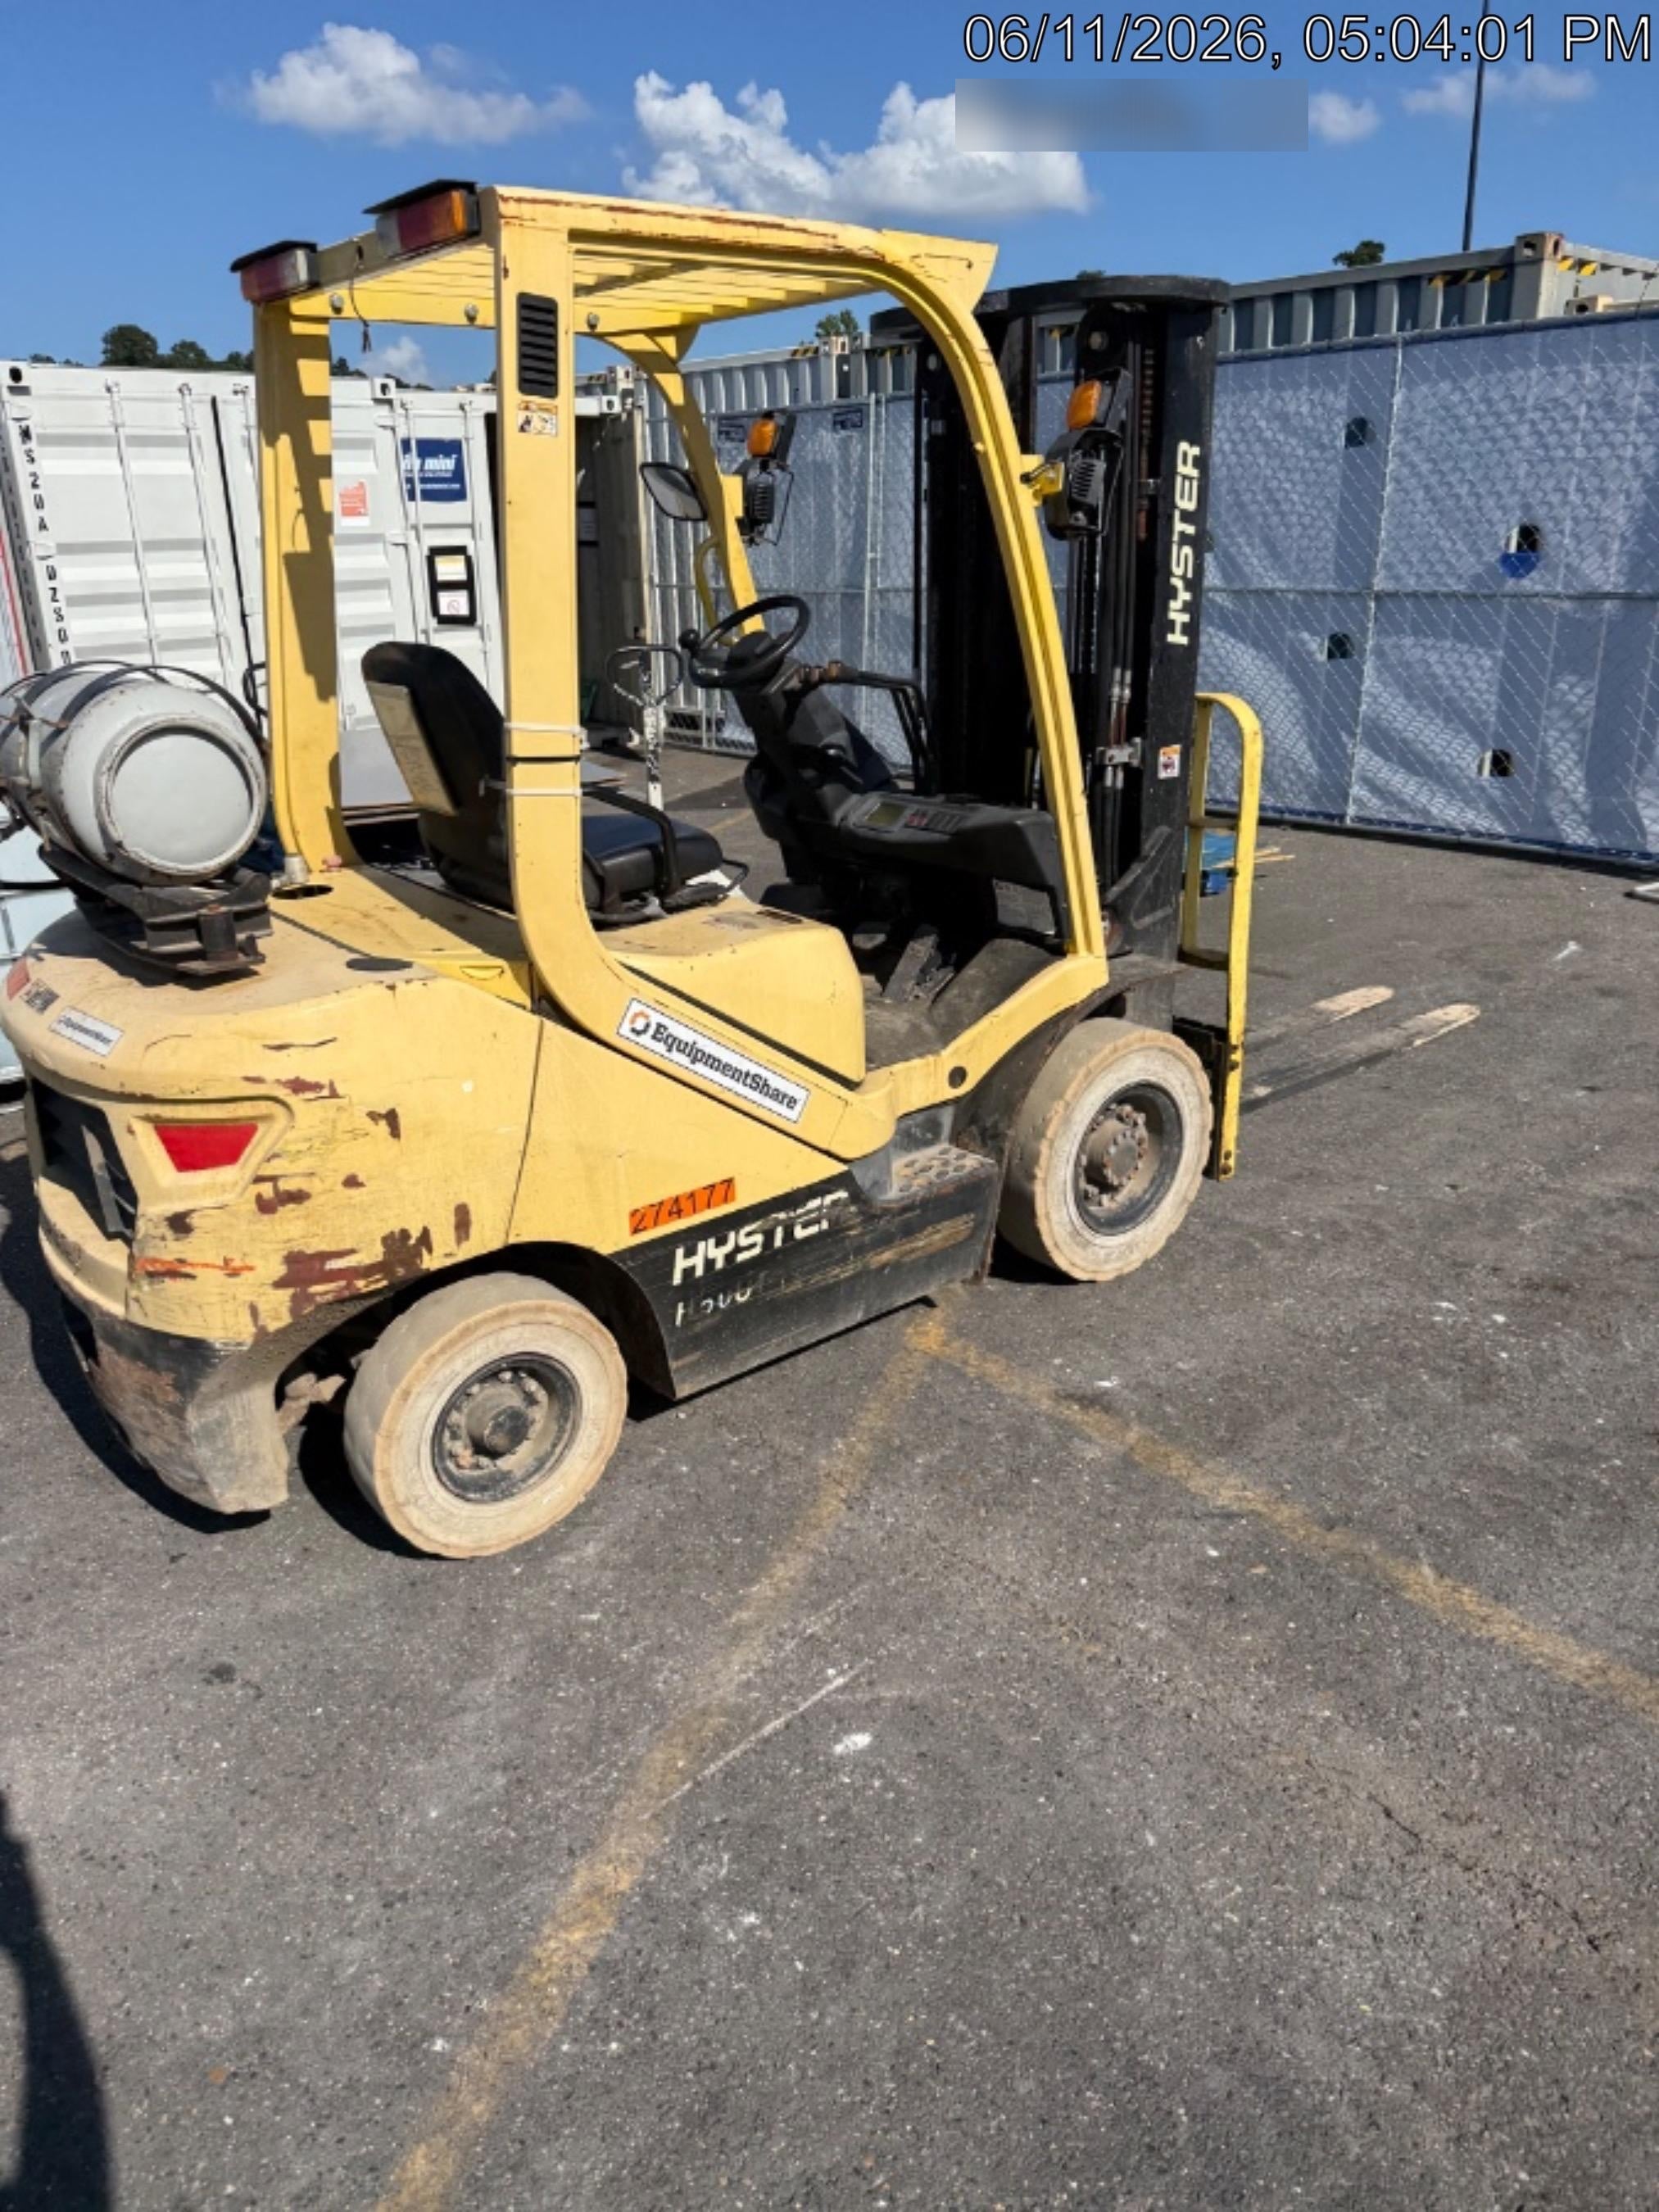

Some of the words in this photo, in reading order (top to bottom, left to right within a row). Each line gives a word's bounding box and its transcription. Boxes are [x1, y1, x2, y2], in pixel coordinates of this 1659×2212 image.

[1167, 440, 1200, 646] HYSTER
[650, 1022, 798, 1110] EquipmentShare
[630, 1179, 734, 1235] 274177
